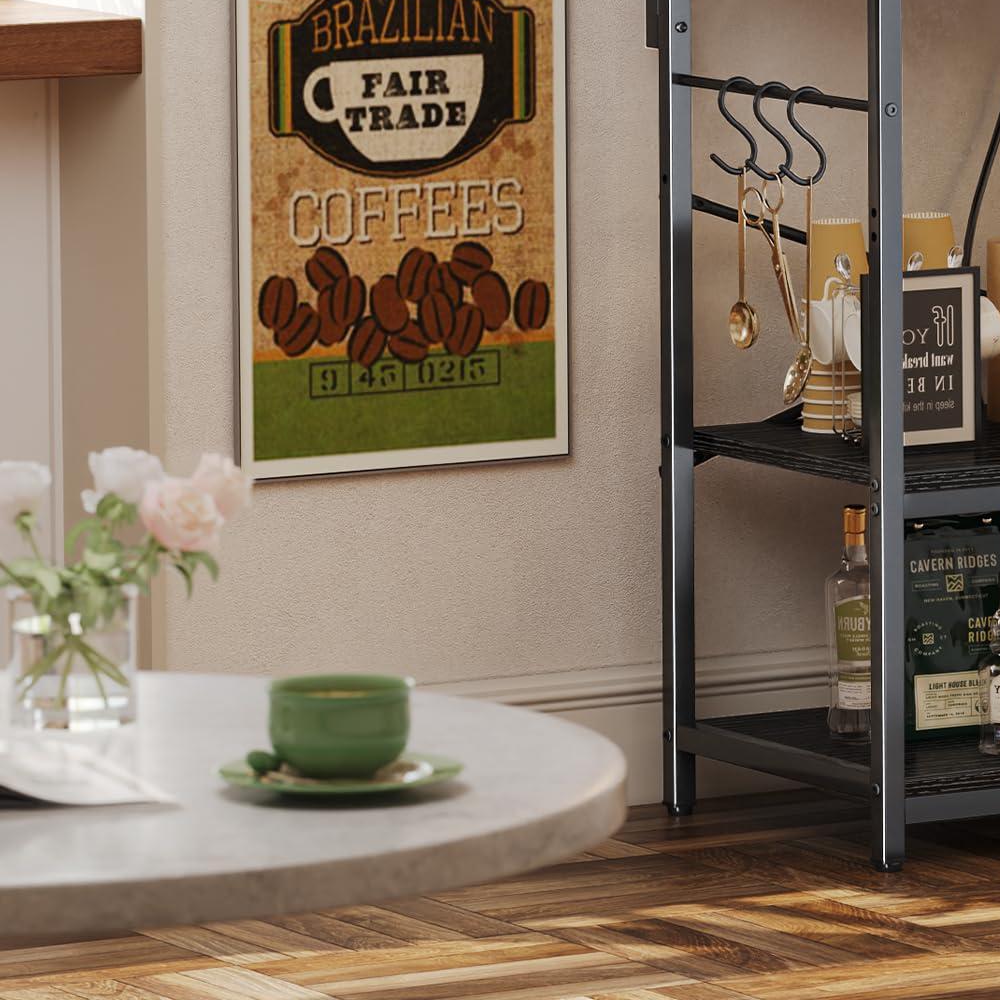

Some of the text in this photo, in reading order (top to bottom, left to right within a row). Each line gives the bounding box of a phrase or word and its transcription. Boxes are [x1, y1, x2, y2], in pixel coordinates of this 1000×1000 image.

[361, 70, 451, 99] FAIR
[345, 101, 466, 132] TRADE
[289, 178, 525, 247] COFFEES
[321, 369, 337, 391] 9
[910, 553, 998, 573] CAVERN RIDGES
[928, 681, 947, 691] LIGHT
[947, 680, 968, 689] HOUSE
